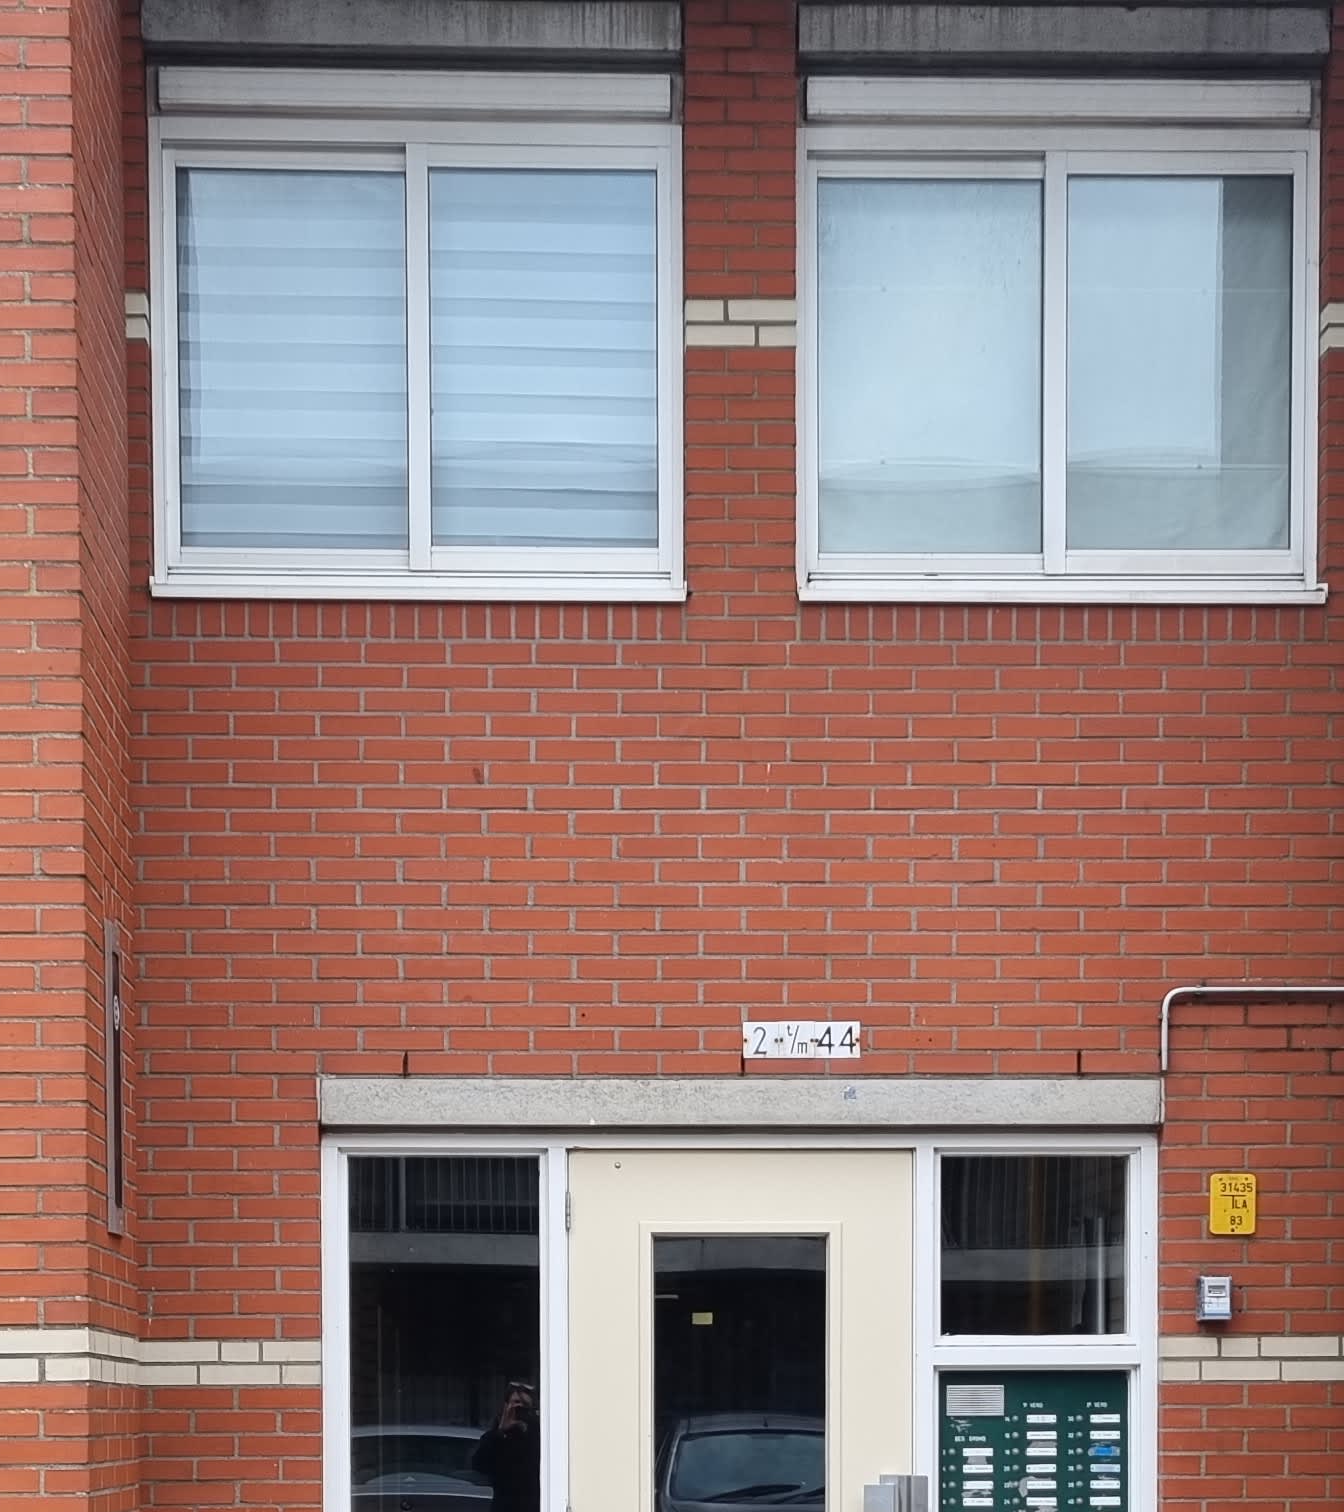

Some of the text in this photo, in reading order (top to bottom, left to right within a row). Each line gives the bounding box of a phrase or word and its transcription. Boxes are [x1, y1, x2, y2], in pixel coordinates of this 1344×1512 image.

[753, 1026, 768, 1055] 2
[816, 1026, 856, 1055] 44
[1230, 1215, 1243, 1226] 83
